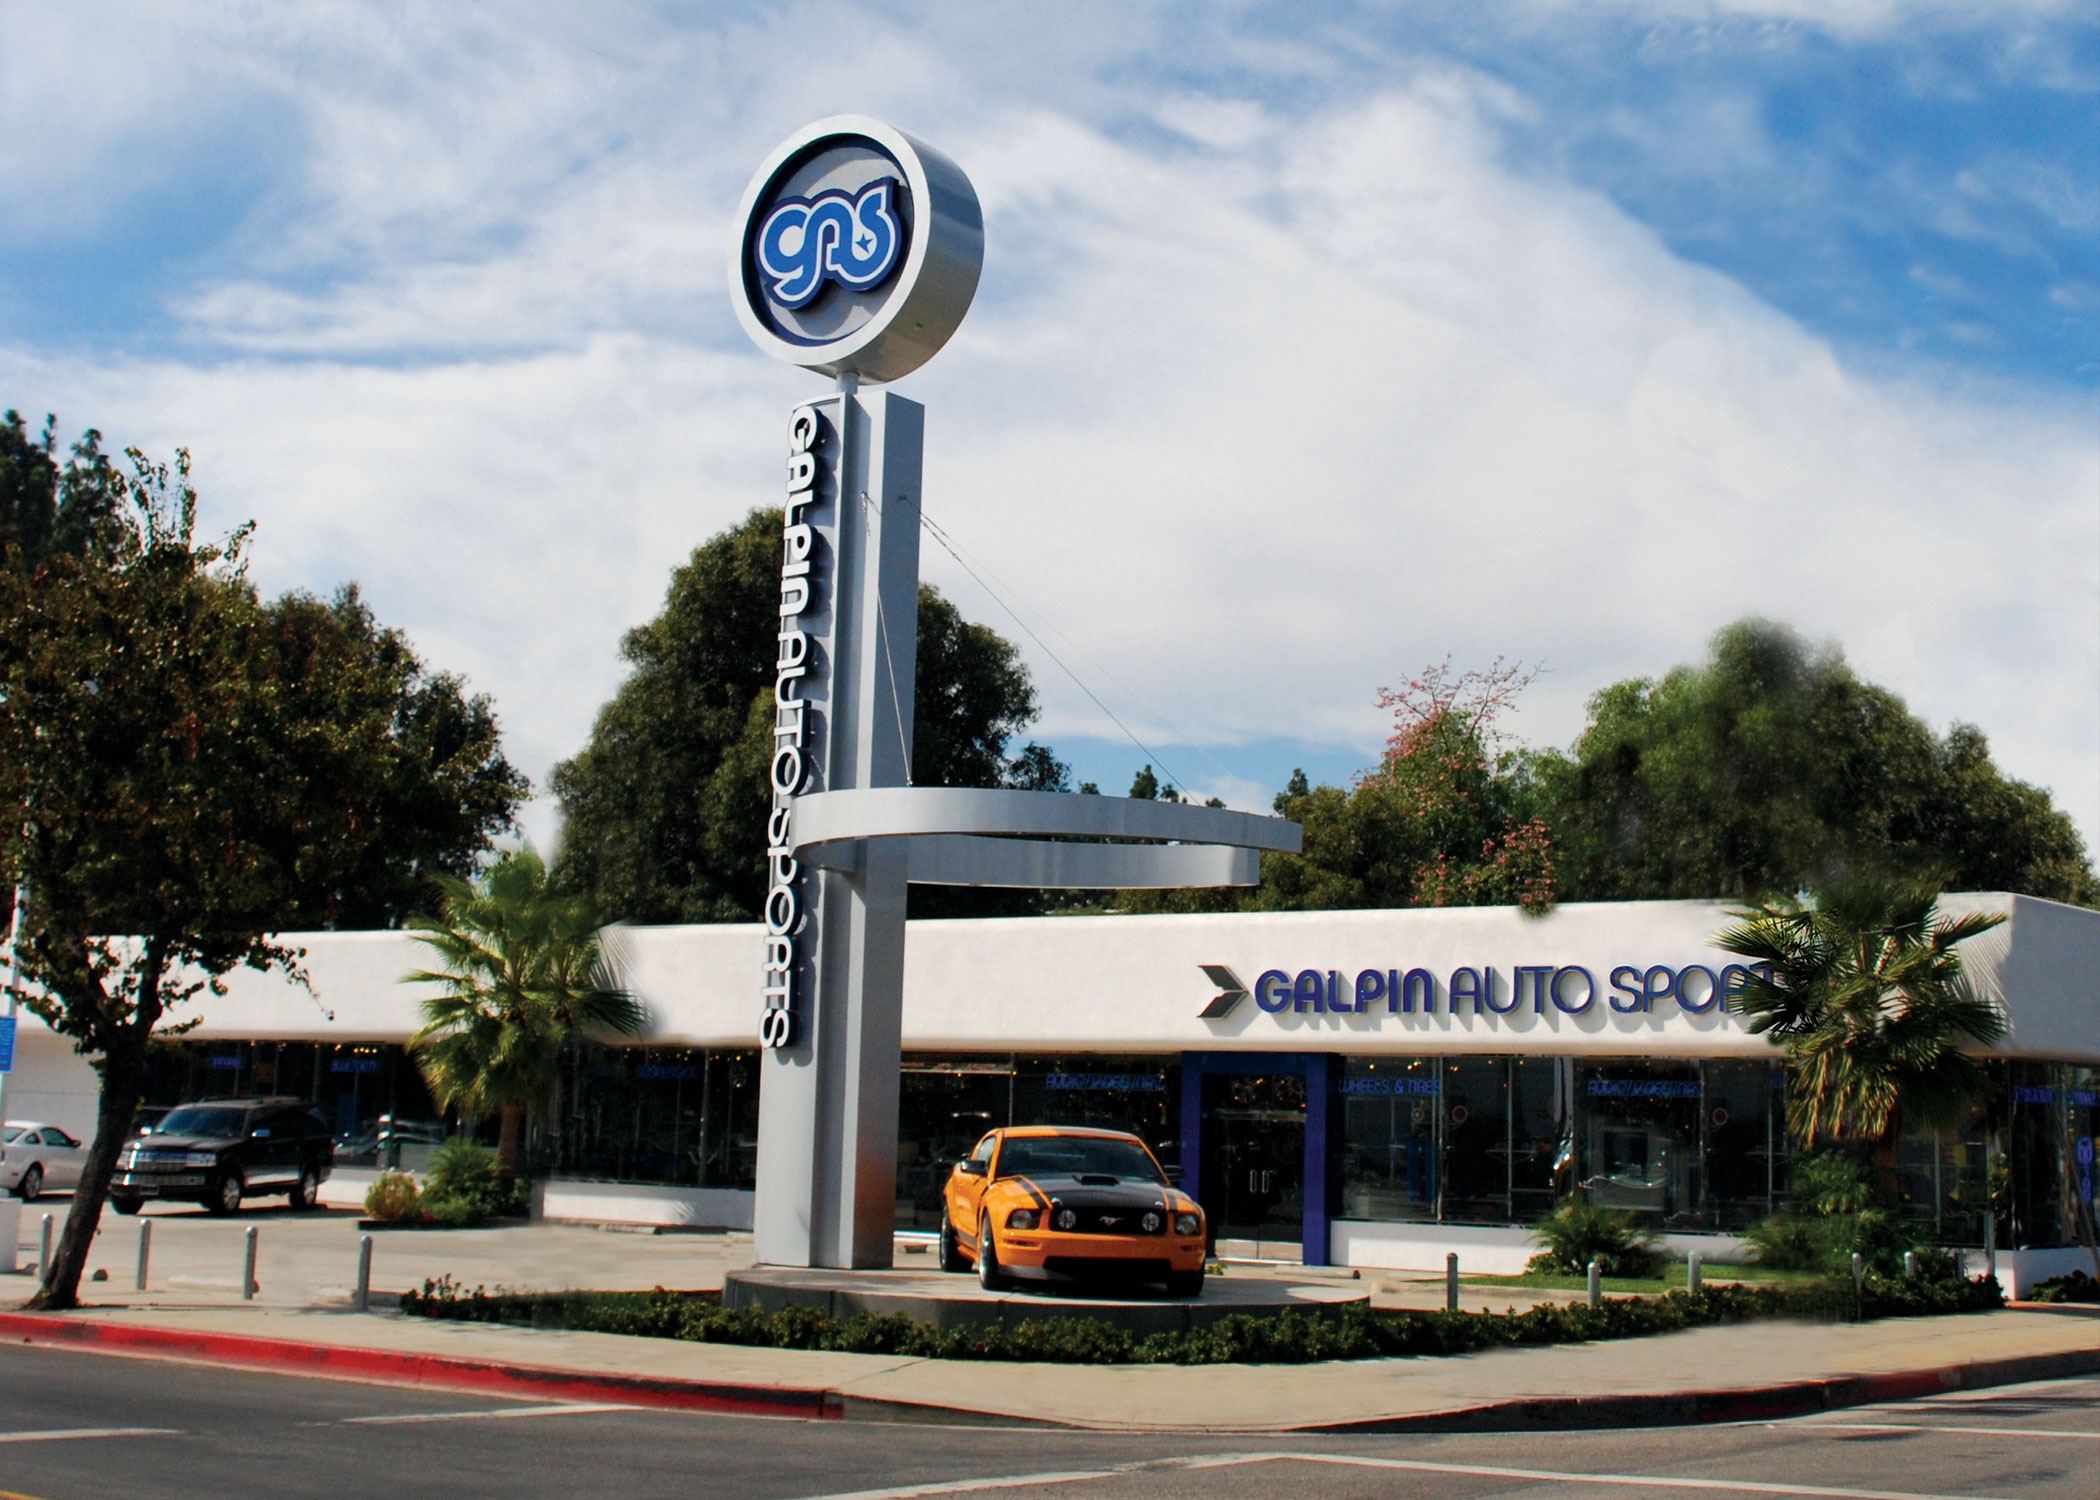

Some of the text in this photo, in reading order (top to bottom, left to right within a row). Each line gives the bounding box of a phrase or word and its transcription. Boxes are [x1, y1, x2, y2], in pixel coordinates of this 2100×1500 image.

[759, 406, 820, 1049] GALPIN AUTO SPORTS
[1255, 968, 1434, 1013] GALPIN
[1449, 964, 1595, 1014] AUTO
[1394, 1078, 1405, 1094] &
